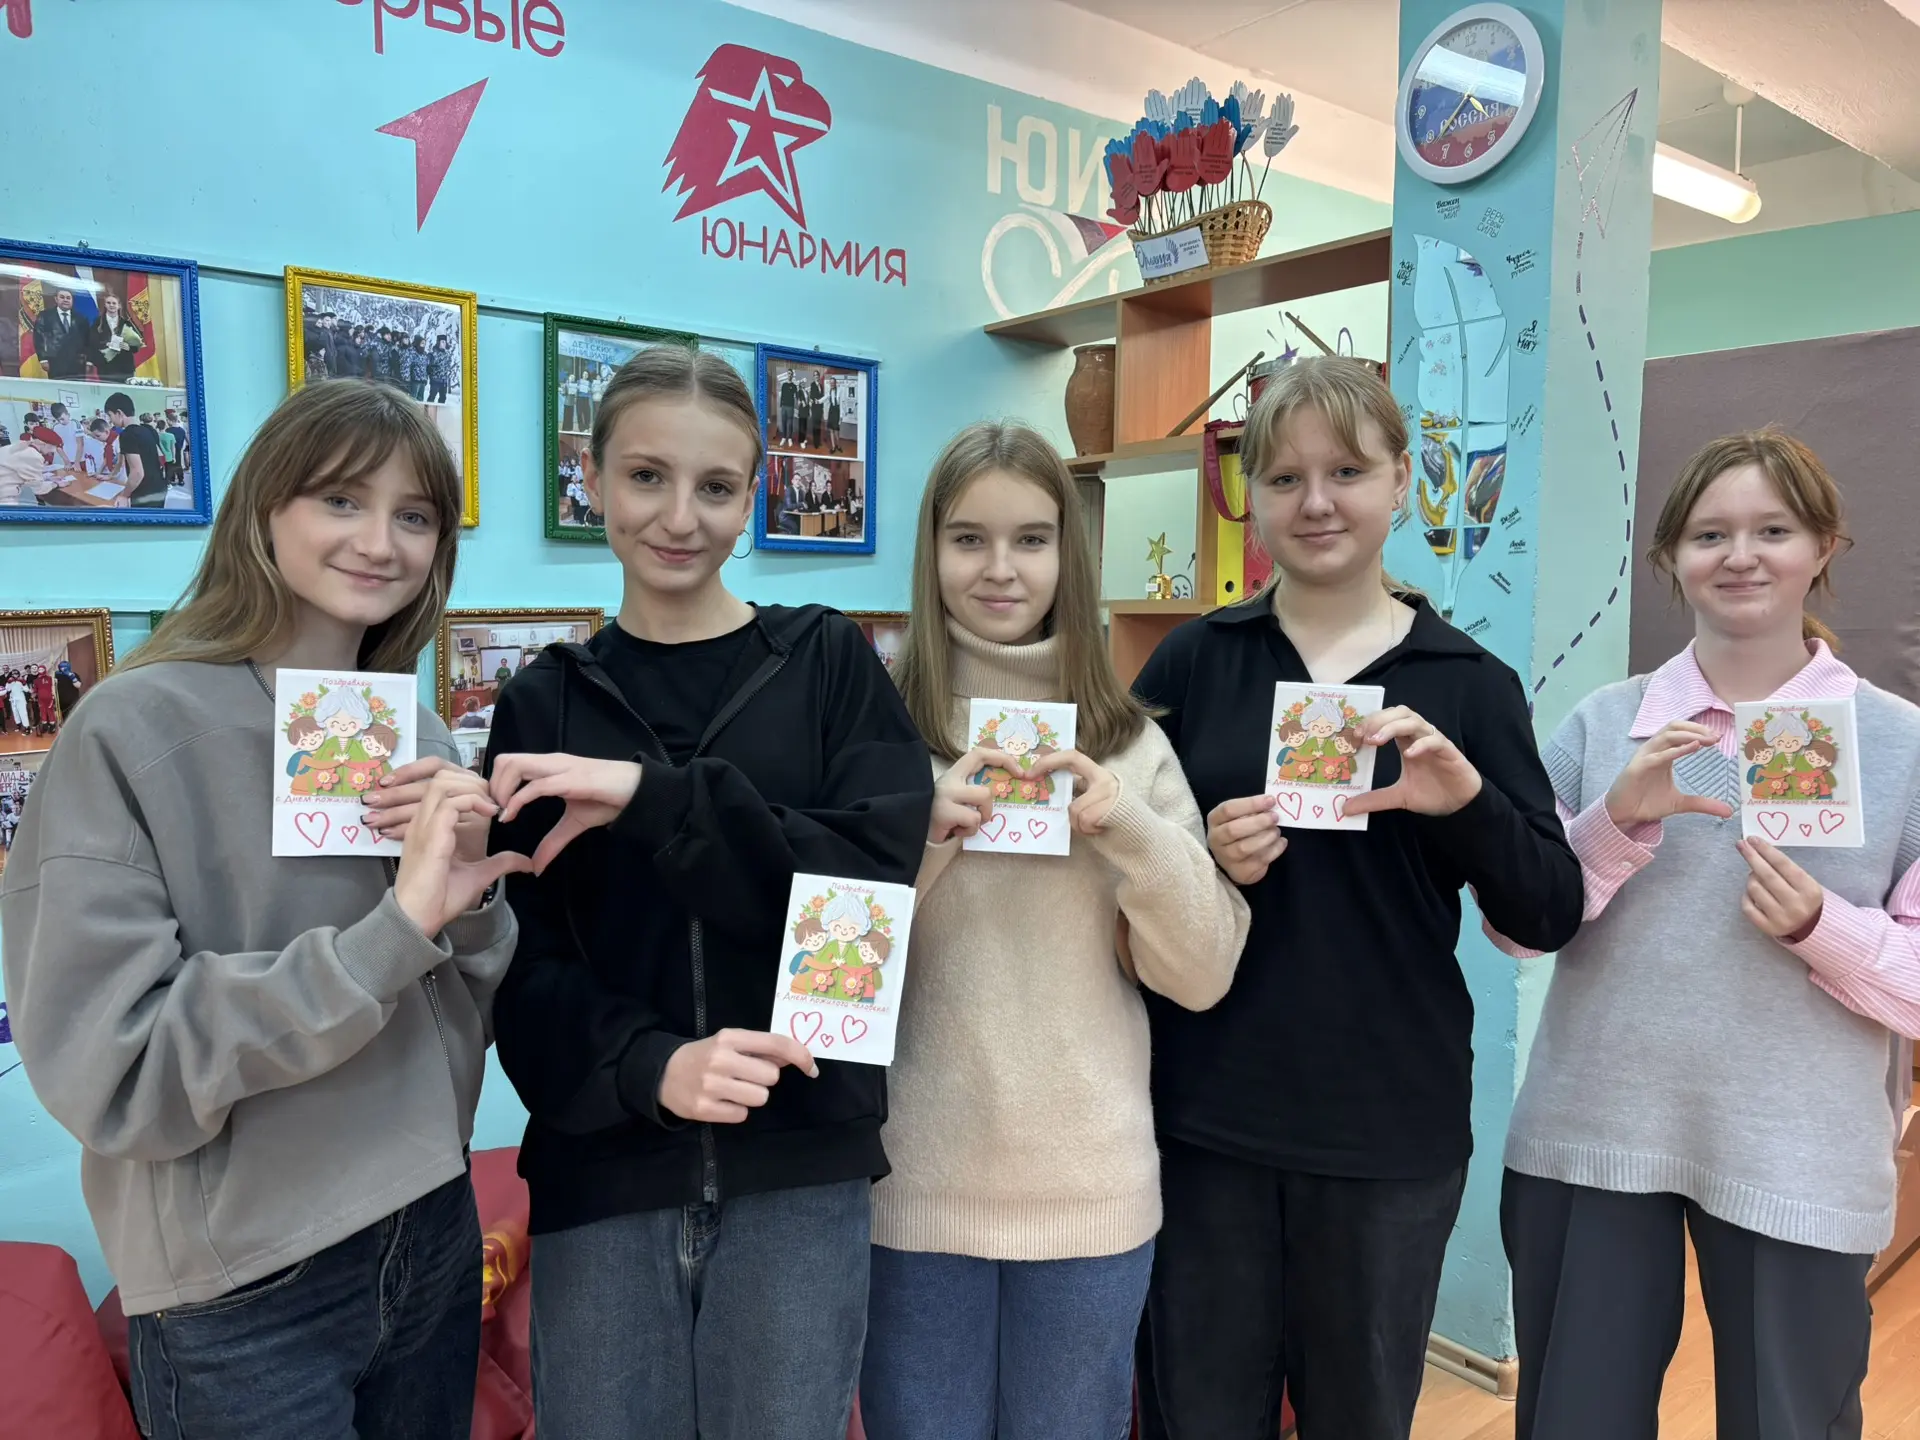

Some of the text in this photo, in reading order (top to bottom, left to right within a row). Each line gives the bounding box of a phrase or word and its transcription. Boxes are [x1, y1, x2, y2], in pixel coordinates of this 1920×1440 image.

[334, 0, 566, 57] рвые
[1417, 105, 1427, 119] 9
[1440, 102, 1500, 133] РОССИЯ
[1426, 129, 1435, 143] 8
[1487, 130, 1496, 145] 5
[1441, 143, 1450, 159] 7
[1464, 143, 1473, 158] 6
[987, 104, 1112, 221] ЮИ
[1484, 207, 1505, 224] ВЕРЬ
[1476, 222, 1500, 238] СИЛЫ
[702, 216, 907, 287] ЮНАРМИЯ
